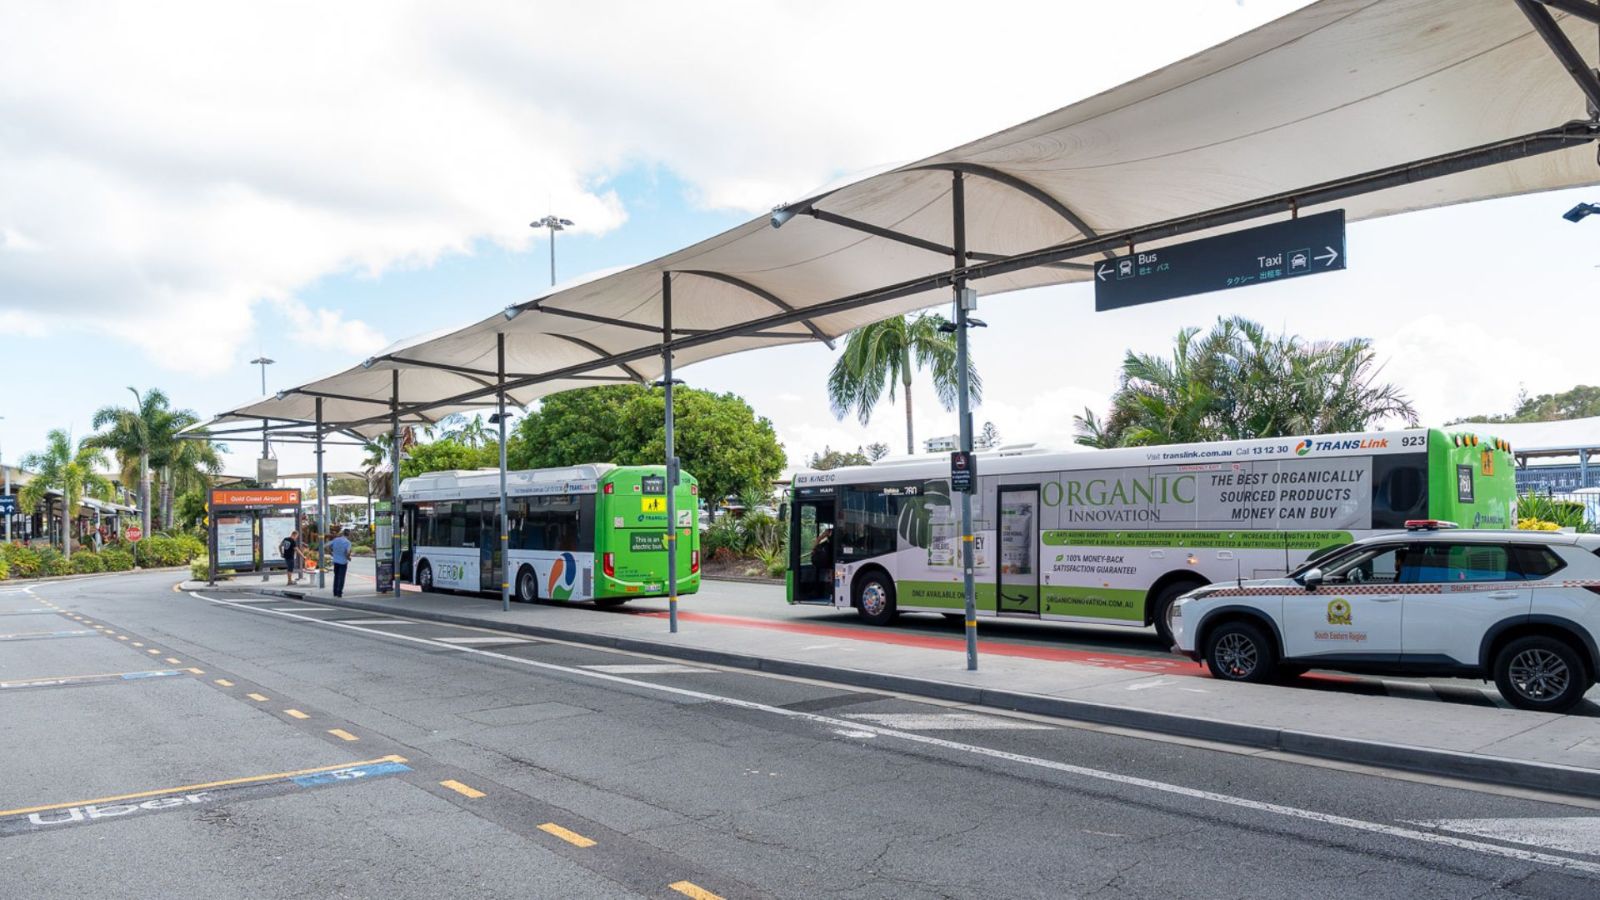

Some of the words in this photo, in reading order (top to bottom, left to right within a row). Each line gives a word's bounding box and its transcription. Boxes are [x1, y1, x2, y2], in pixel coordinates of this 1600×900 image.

[1138, 253, 1158, 265] Bus
[1257, 253, 1282, 268] Taxi
[1156, 262, 1170, 273] バス
[1226, 275, 1255, 287] タクシー
[1315, 438, 1389, 451] TRANSLink
[1402, 436, 1426, 447] 923
[1163, 449, 1232, 460] translink.com.au
[1253, 447, 1262, 455] 13
[1264, 446, 1274, 454] 12
[1277, 445, 1289, 453] 30
[1211, 474, 1233, 486] THE
[1237, 473, 1268, 485] BEST
[1272, 470, 1364, 484] ORGANICALLY
[1042, 475, 1196, 507] ORGANIC
[1220, 490, 1276, 503] SOURCED
[1280, 488, 1351, 501] PRODUCTS
[263, 495, 283, 503] Airport
[1069, 509, 1161, 522] INNOVATION
[1231, 508, 1275, 520] MONEY
[1279, 507, 1306, 519] CAN
[1310, 507, 1337, 519] BUY
[126, 530, 142, 539] STOP
[1066, 554, 1081, 562] 100%
[1082, 554, 1124, 564] MONEY-BACK
[1053, 564, 1095, 573] SATISFACTION
[1096, 565, 1137, 575] GUARANTEE!
[912, 589, 926, 597] ONLY
[926, 590, 956, 599] AVAILABLE
[1451, 584, 1470, 592] State
[1314, 631, 1329, 640] South
[1330, 631, 1348, 640] Eastern
[1349, 632, 1367, 643] Region
[28, 792, 210, 825] Uber
